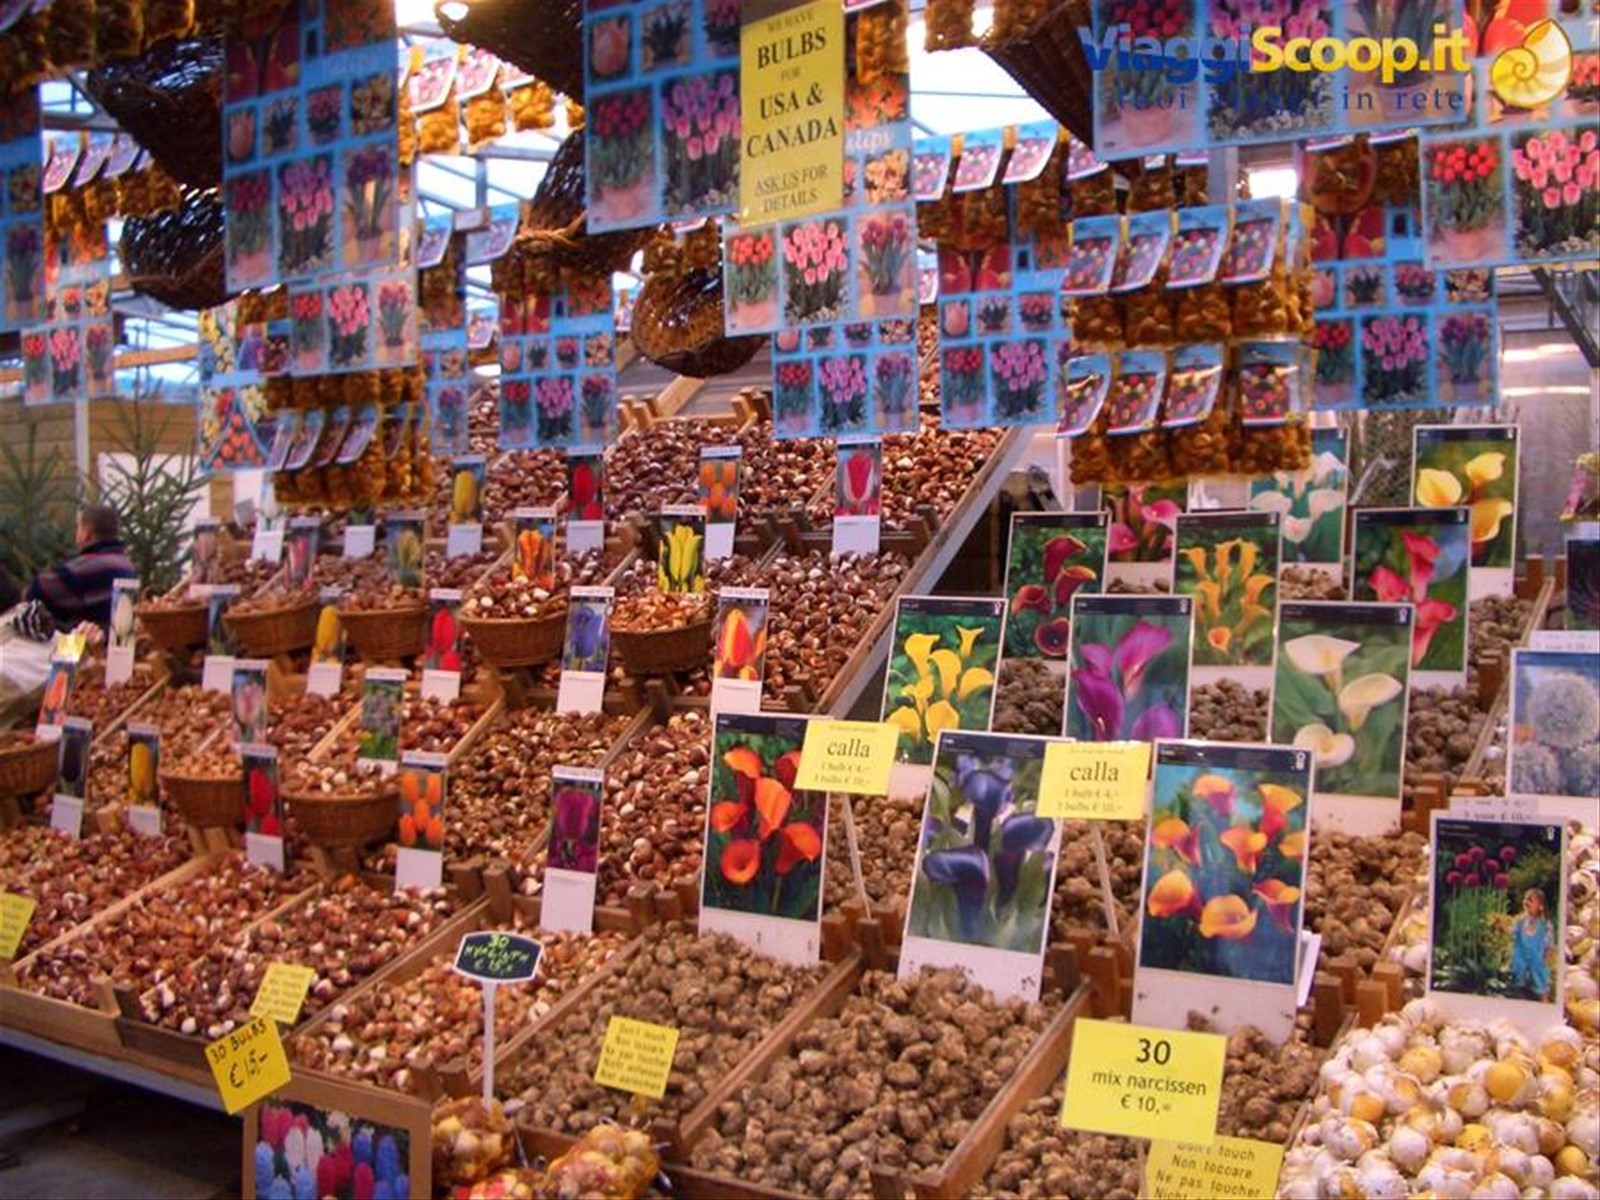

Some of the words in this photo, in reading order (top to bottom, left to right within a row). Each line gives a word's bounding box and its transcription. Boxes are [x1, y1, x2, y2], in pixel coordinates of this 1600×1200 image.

[758, 26, 826, 69] BULBS
[760, 89, 799, 119] USA
[806, 82, 823, 106] &
[747, 116, 838, 158] CANADA
[802, 163, 828, 184] FOR
[763, 187, 820, 213] DETAILS
[827, 738, 870, 758] calla
[1069, 761, 1119, 781] calla
[488, 933, 510, 949] 30
[230, 1018, 268, 1052] BULBS
[1136, 1038, 1171, 1065] 30
[1092, 1070, 1121, 1086] mix
[1127, 1075, 1207, 1096] narcissen
[1121, 1094, 1131, 1109] €
[1219, 1144, 1254, 1161] touch
[1172, 1154, 1197, 1168] Non
[1203, 1160, 1253, 1179] toccare
[1156, 1168, 1172, 1182] Ne
[1179, 1176, 1202, 1188] pas
[1210, 1179, 1261, 1198] toucher
